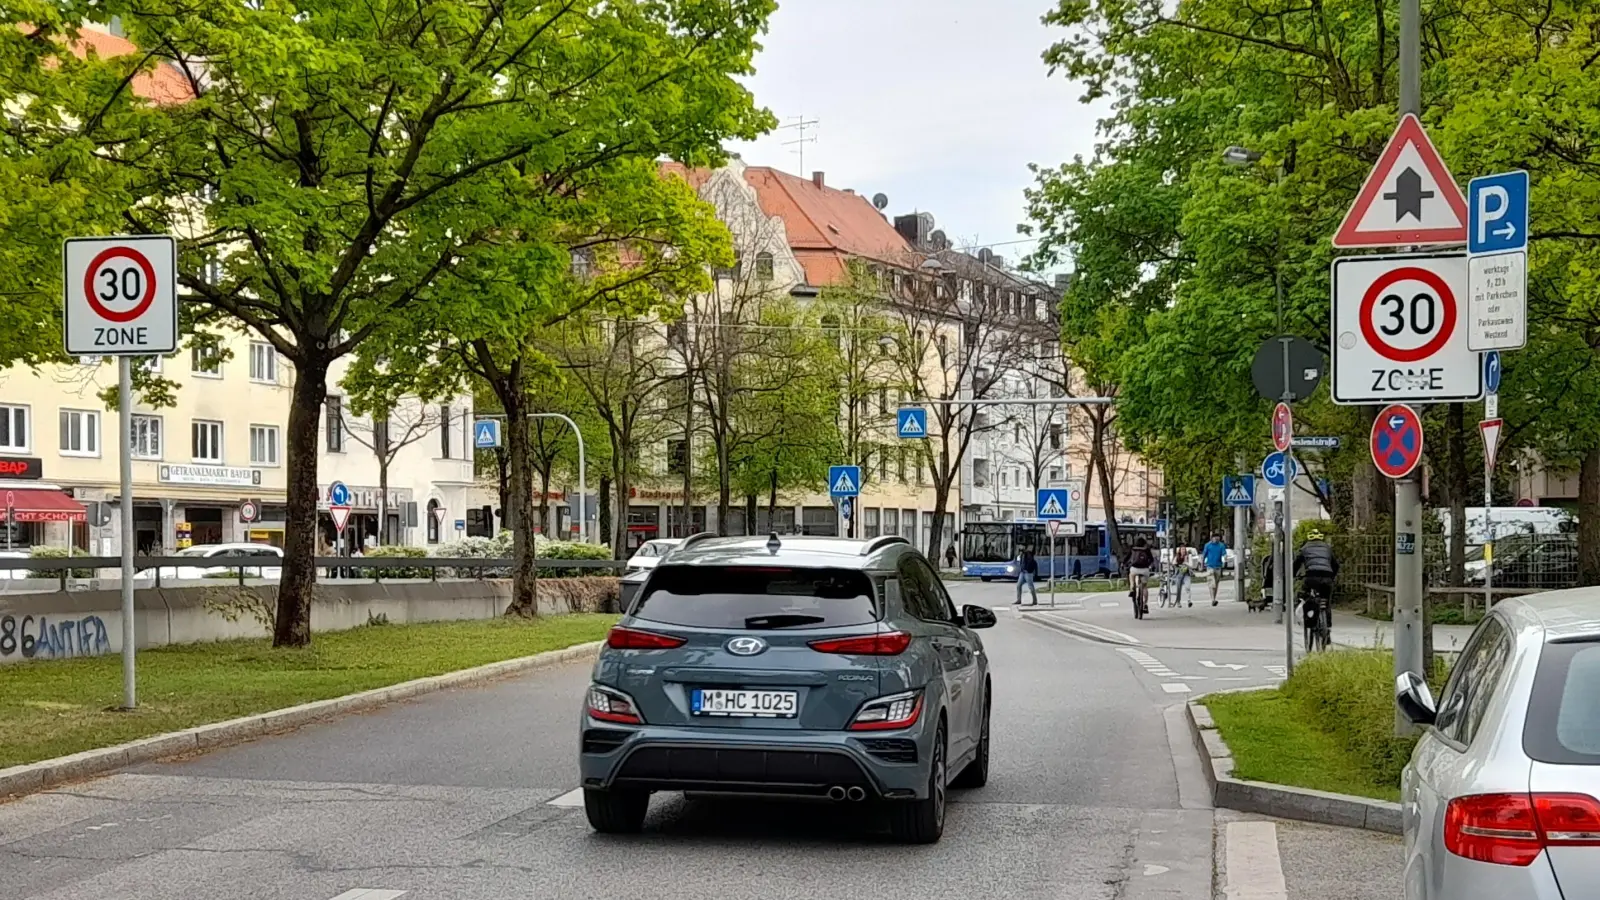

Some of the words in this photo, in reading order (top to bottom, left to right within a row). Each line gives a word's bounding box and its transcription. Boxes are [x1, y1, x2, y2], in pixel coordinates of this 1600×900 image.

[1477, 185, 1509, 244] P
[100, 267, 141, 301] 30
[1486, 290, 1518, 300] Parkschein
[1380, 293, 1435, 336] 30
[1487, 304, 1501, 313] oder
[1478, 317, 1514, 327] Parkausweis
[94, 327, 148, 346] ZONE
[1484, 329, 1508, 339] Westend
[1290, 437, 1337, 447] estendstraße
[230, 469, 251, 479] BAYER
[34, 614, 112, 660] ANTIFA
[703, 692, 716, 709] M
[724, 693, 747, 711] HC
[751, 693, 795, 713] 1025
